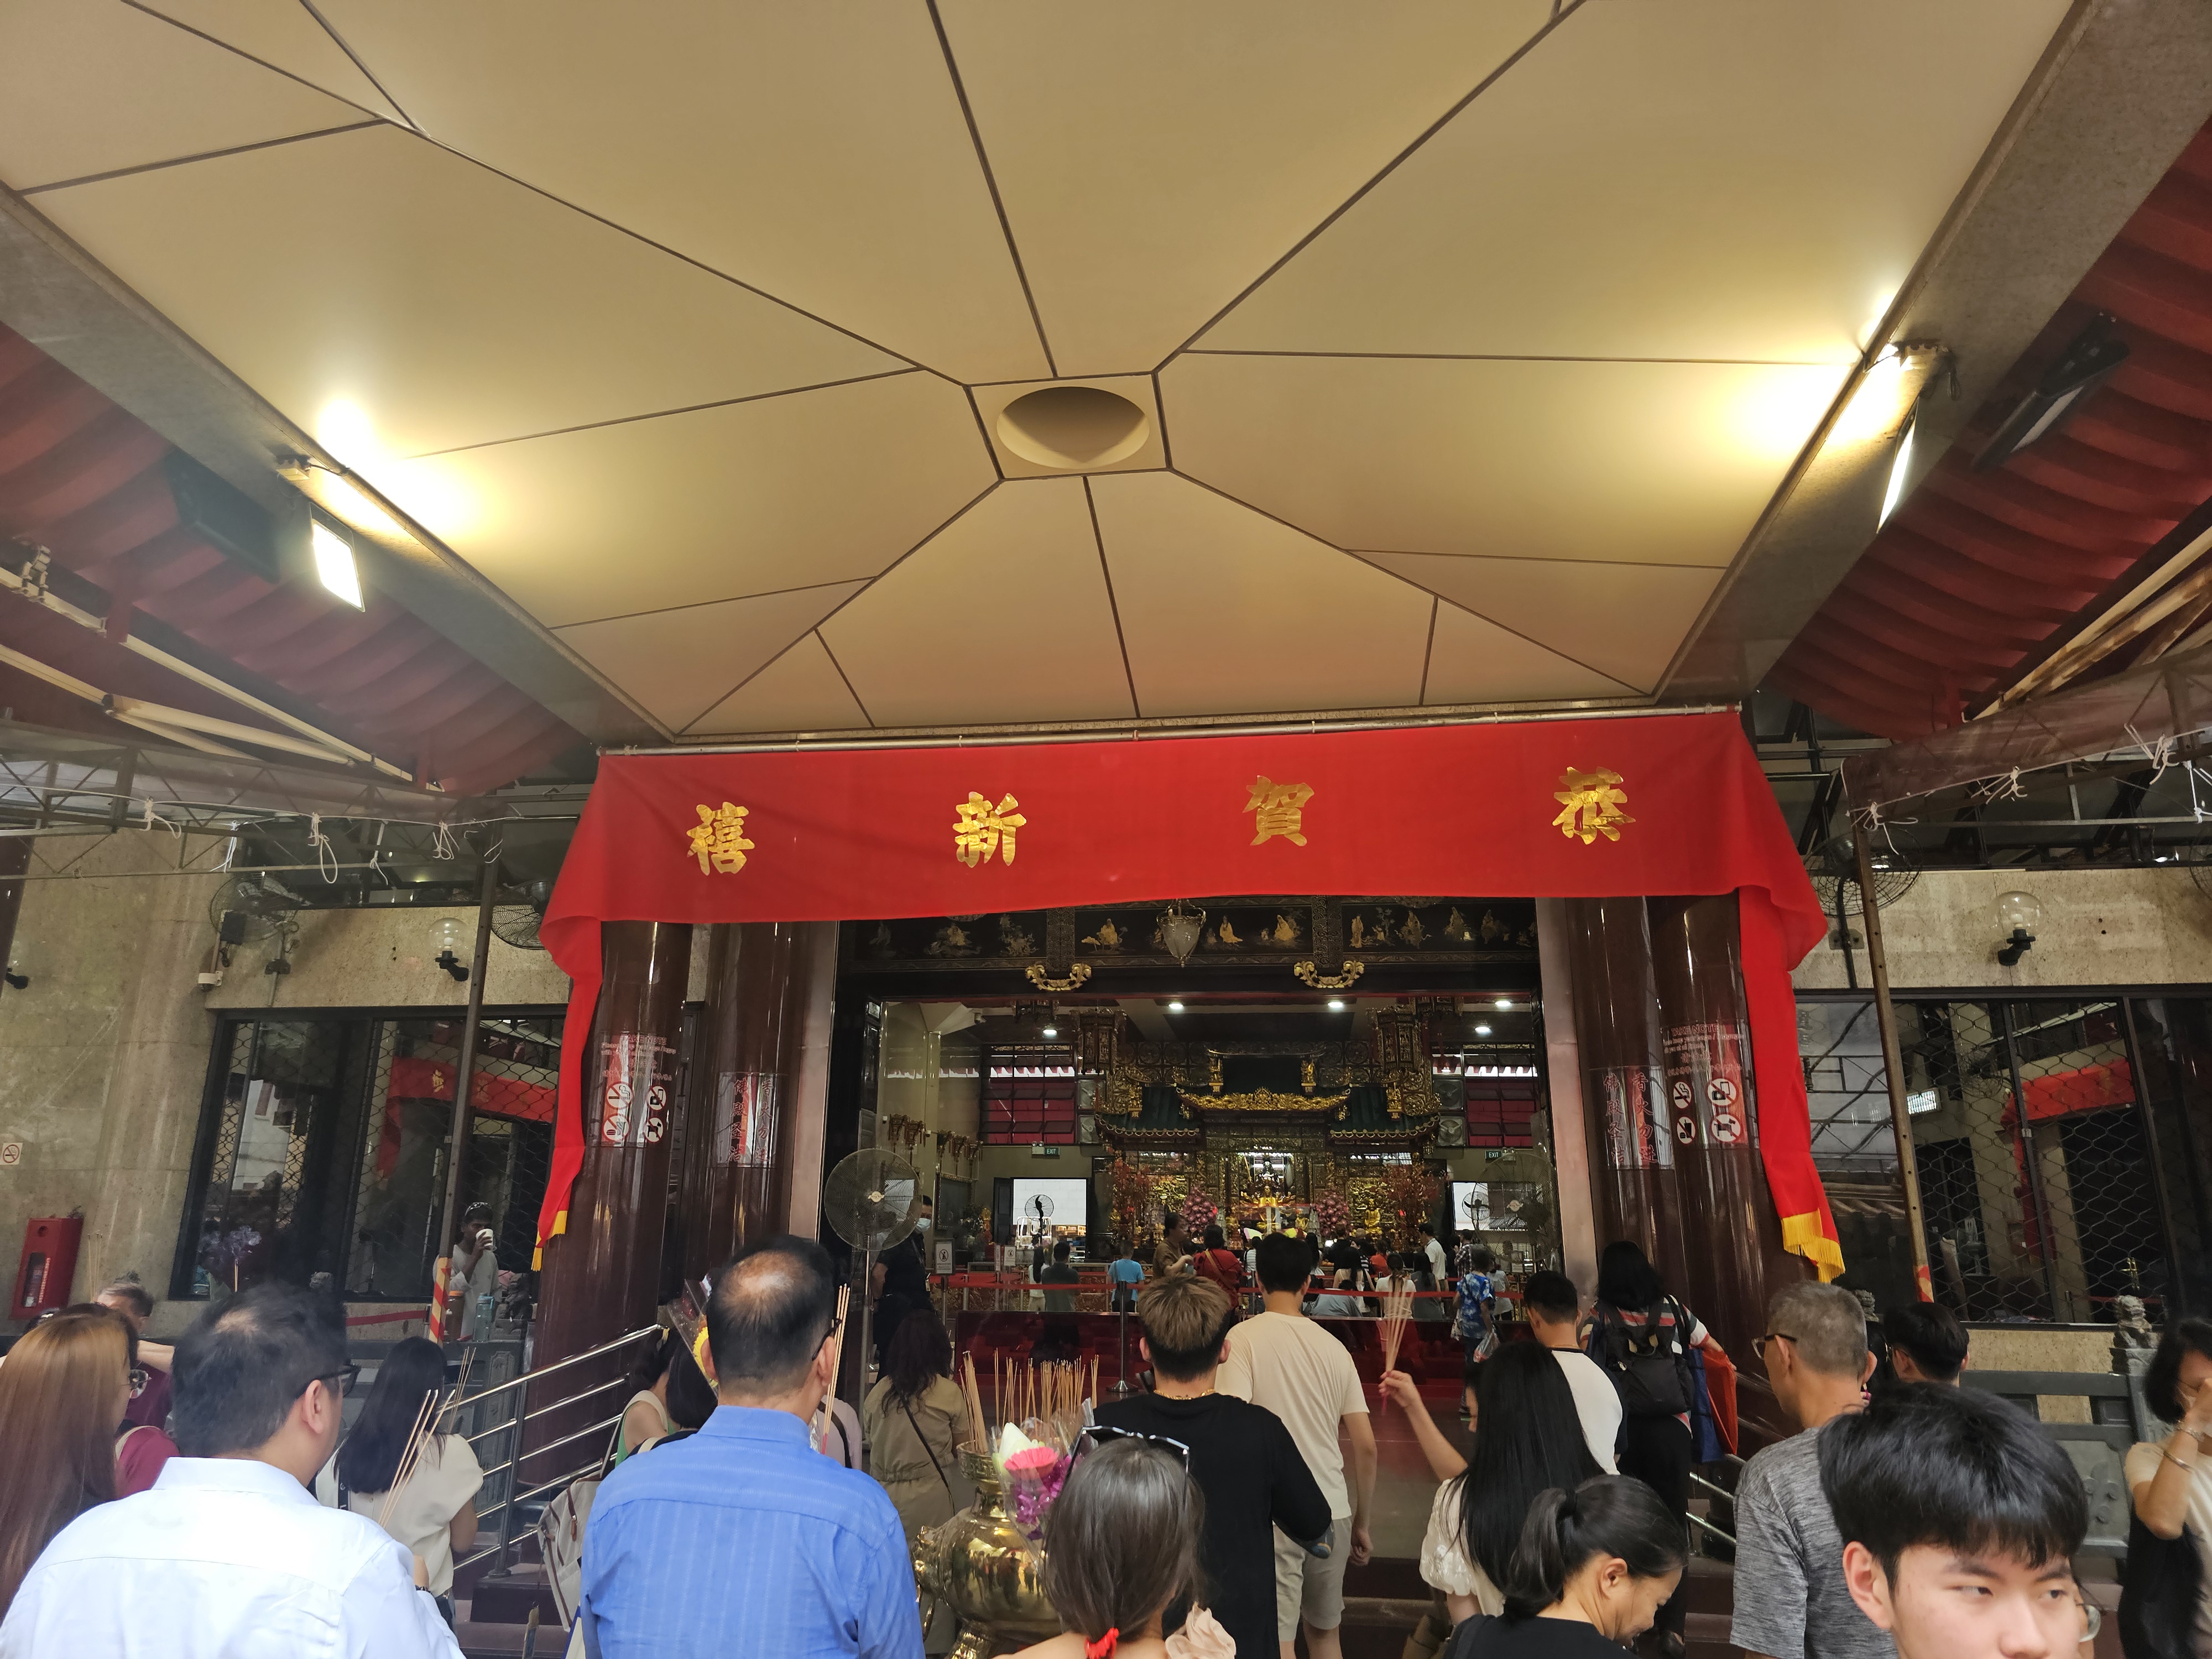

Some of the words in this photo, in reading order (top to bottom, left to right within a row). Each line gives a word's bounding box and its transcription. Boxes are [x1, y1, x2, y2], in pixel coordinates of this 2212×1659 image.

[1671, 1026, 1691, 1036] TAKE
[1692, 1024, 1719, 1035] NOTE
[646, 1035, 667, 1045] NOTE
